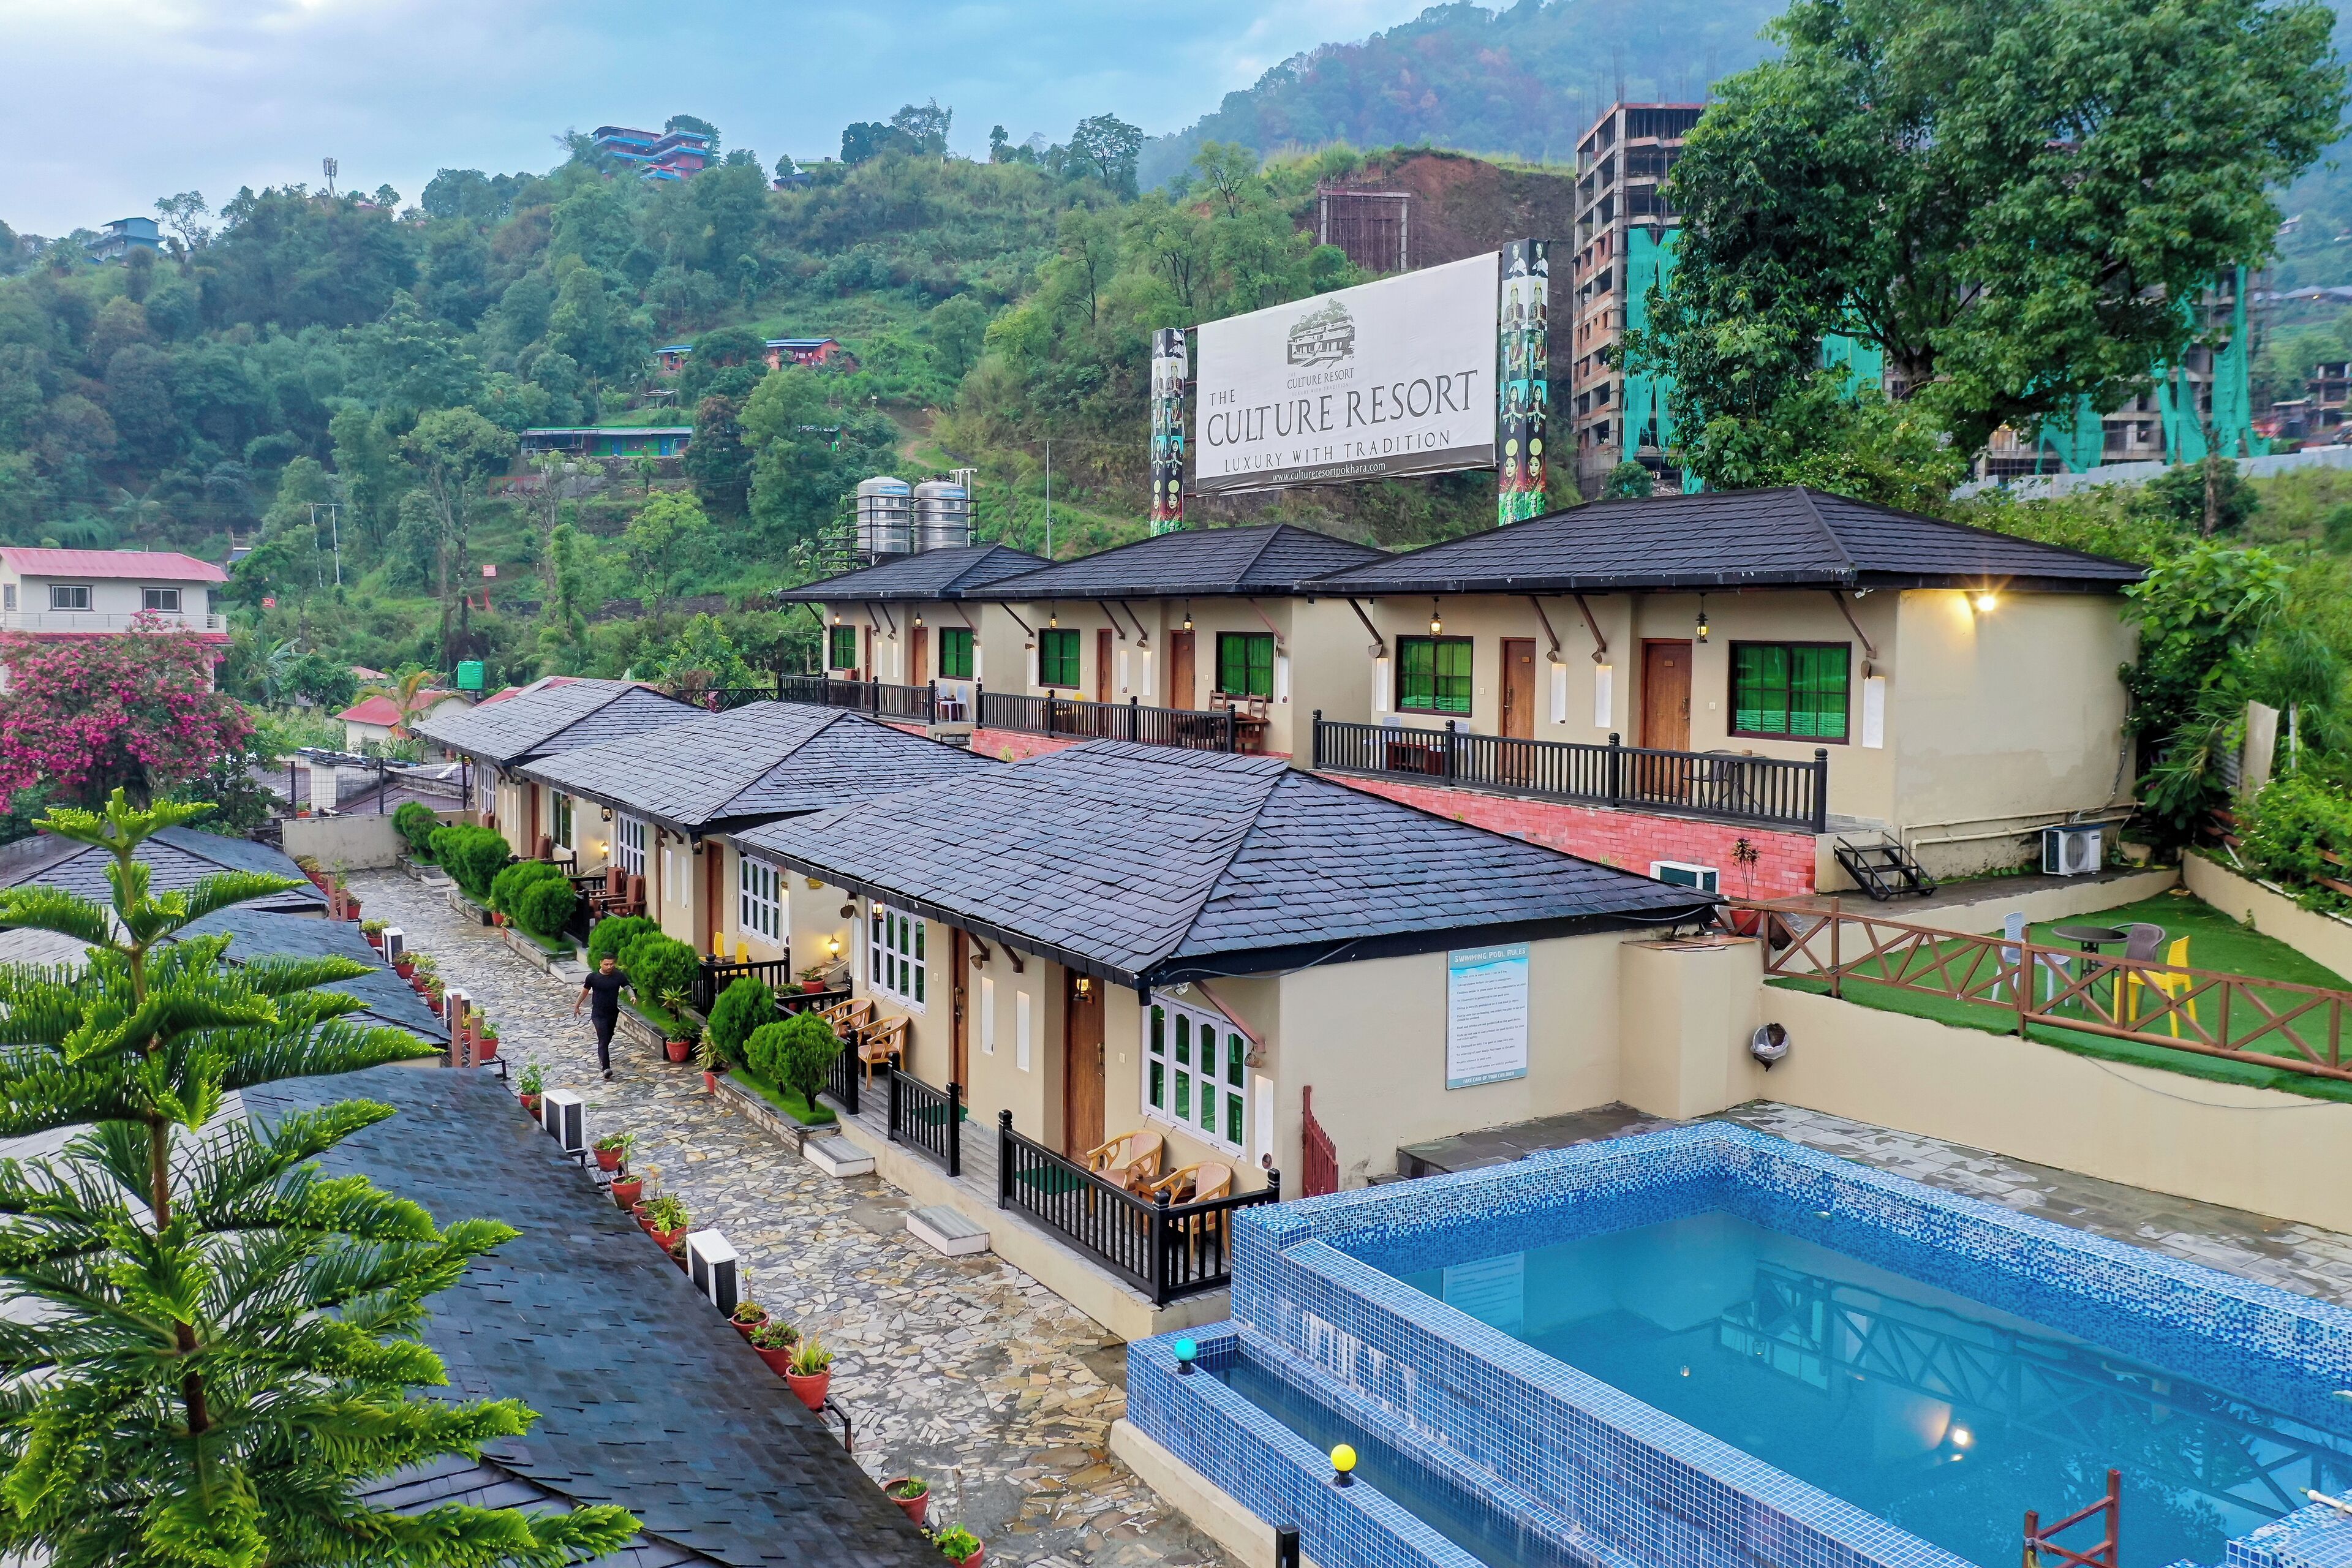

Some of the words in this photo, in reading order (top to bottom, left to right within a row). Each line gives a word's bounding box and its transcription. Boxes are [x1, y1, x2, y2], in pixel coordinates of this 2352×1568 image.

[1287, 374, 1322, 389] CULTURE
[1324, 368, 1354, 383] RESORT
[1324, 382, 1349, 391] TRADITION
[1210, 389, 1235, 406] THE
[1207, 394, 1334, 447] CULTURE
[1346, 369, 1478, 428] RESORT
[1225, 452, 1283, 472] LUXURY
[1292, 446, 1333, 464] WITH
[1343, 430, 1450, 458] TRADITION
[1272, 462, 1386, 482] www.cultureresortpokhara.com
[1454, 952, 1487, 963] SWIMMING
[1507, 948, 1526, 956] RULES
